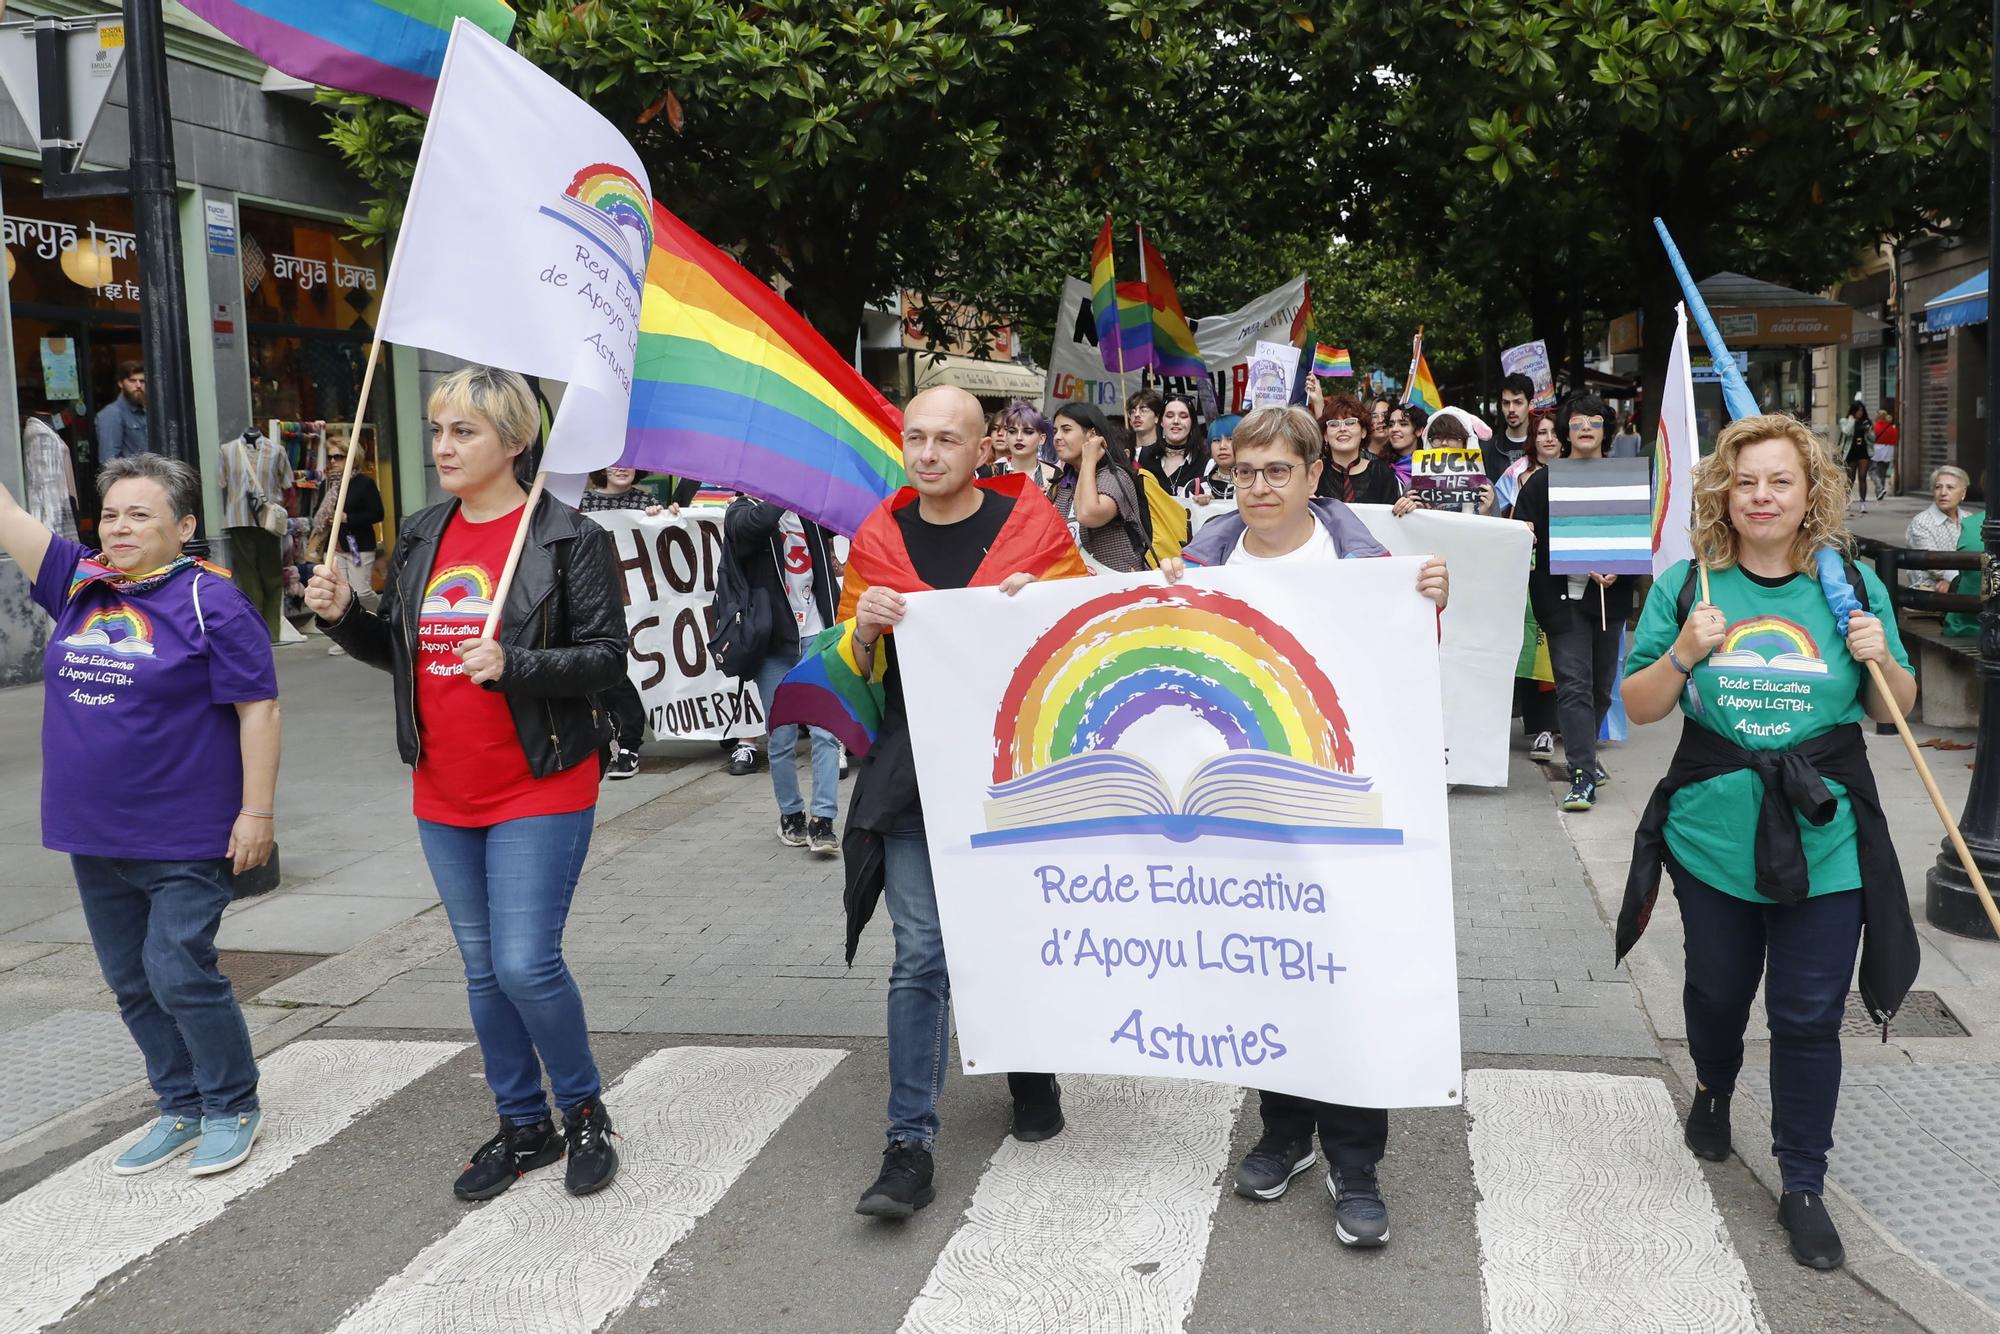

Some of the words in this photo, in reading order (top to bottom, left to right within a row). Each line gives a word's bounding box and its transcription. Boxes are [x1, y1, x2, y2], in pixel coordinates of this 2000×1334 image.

[87, 220, 138, 260] tar
[272, 254, 328, 290] arya
[332, 257, 377, 290] tara
[575, 244, 610, 283] Red
[539, 264, 569, 287] de
[578, 282, 625, 332] Apoyo
[1053, 372, 1117, 404] LGBTIQ
[1421, 452, 1480, 474] FUCK
[1429, 475, 1470, 489] THE
[434, 623, 480, 636] Educativa
[422, 640, 449, 654] Apoyo
[64, 651, 89, 664] Rede
[90, 655, 135, 671] Educativa
[95, 671, 135, 686] LGTBI+
[1718, 676, 1750, 690] Rede
[1753, 679, 1811, 694] Educativa
[68, 688, 116, 706] Asturies
[1717, 695, 1762, 711] d'Apoyu
[1765, 697, 1814, 712] LGTBI+
[1735, 719, 1792, 737] Asturies
[1033, 863, 1140, 904] Rede
[1146, 864, 1327, 914] Educativa
[1041, 927, 1188, 980] d'Apoyu
[1196, 930, 1348, 985] LGTBI+
[1110, 1008, 1288, 1068] Asturies
